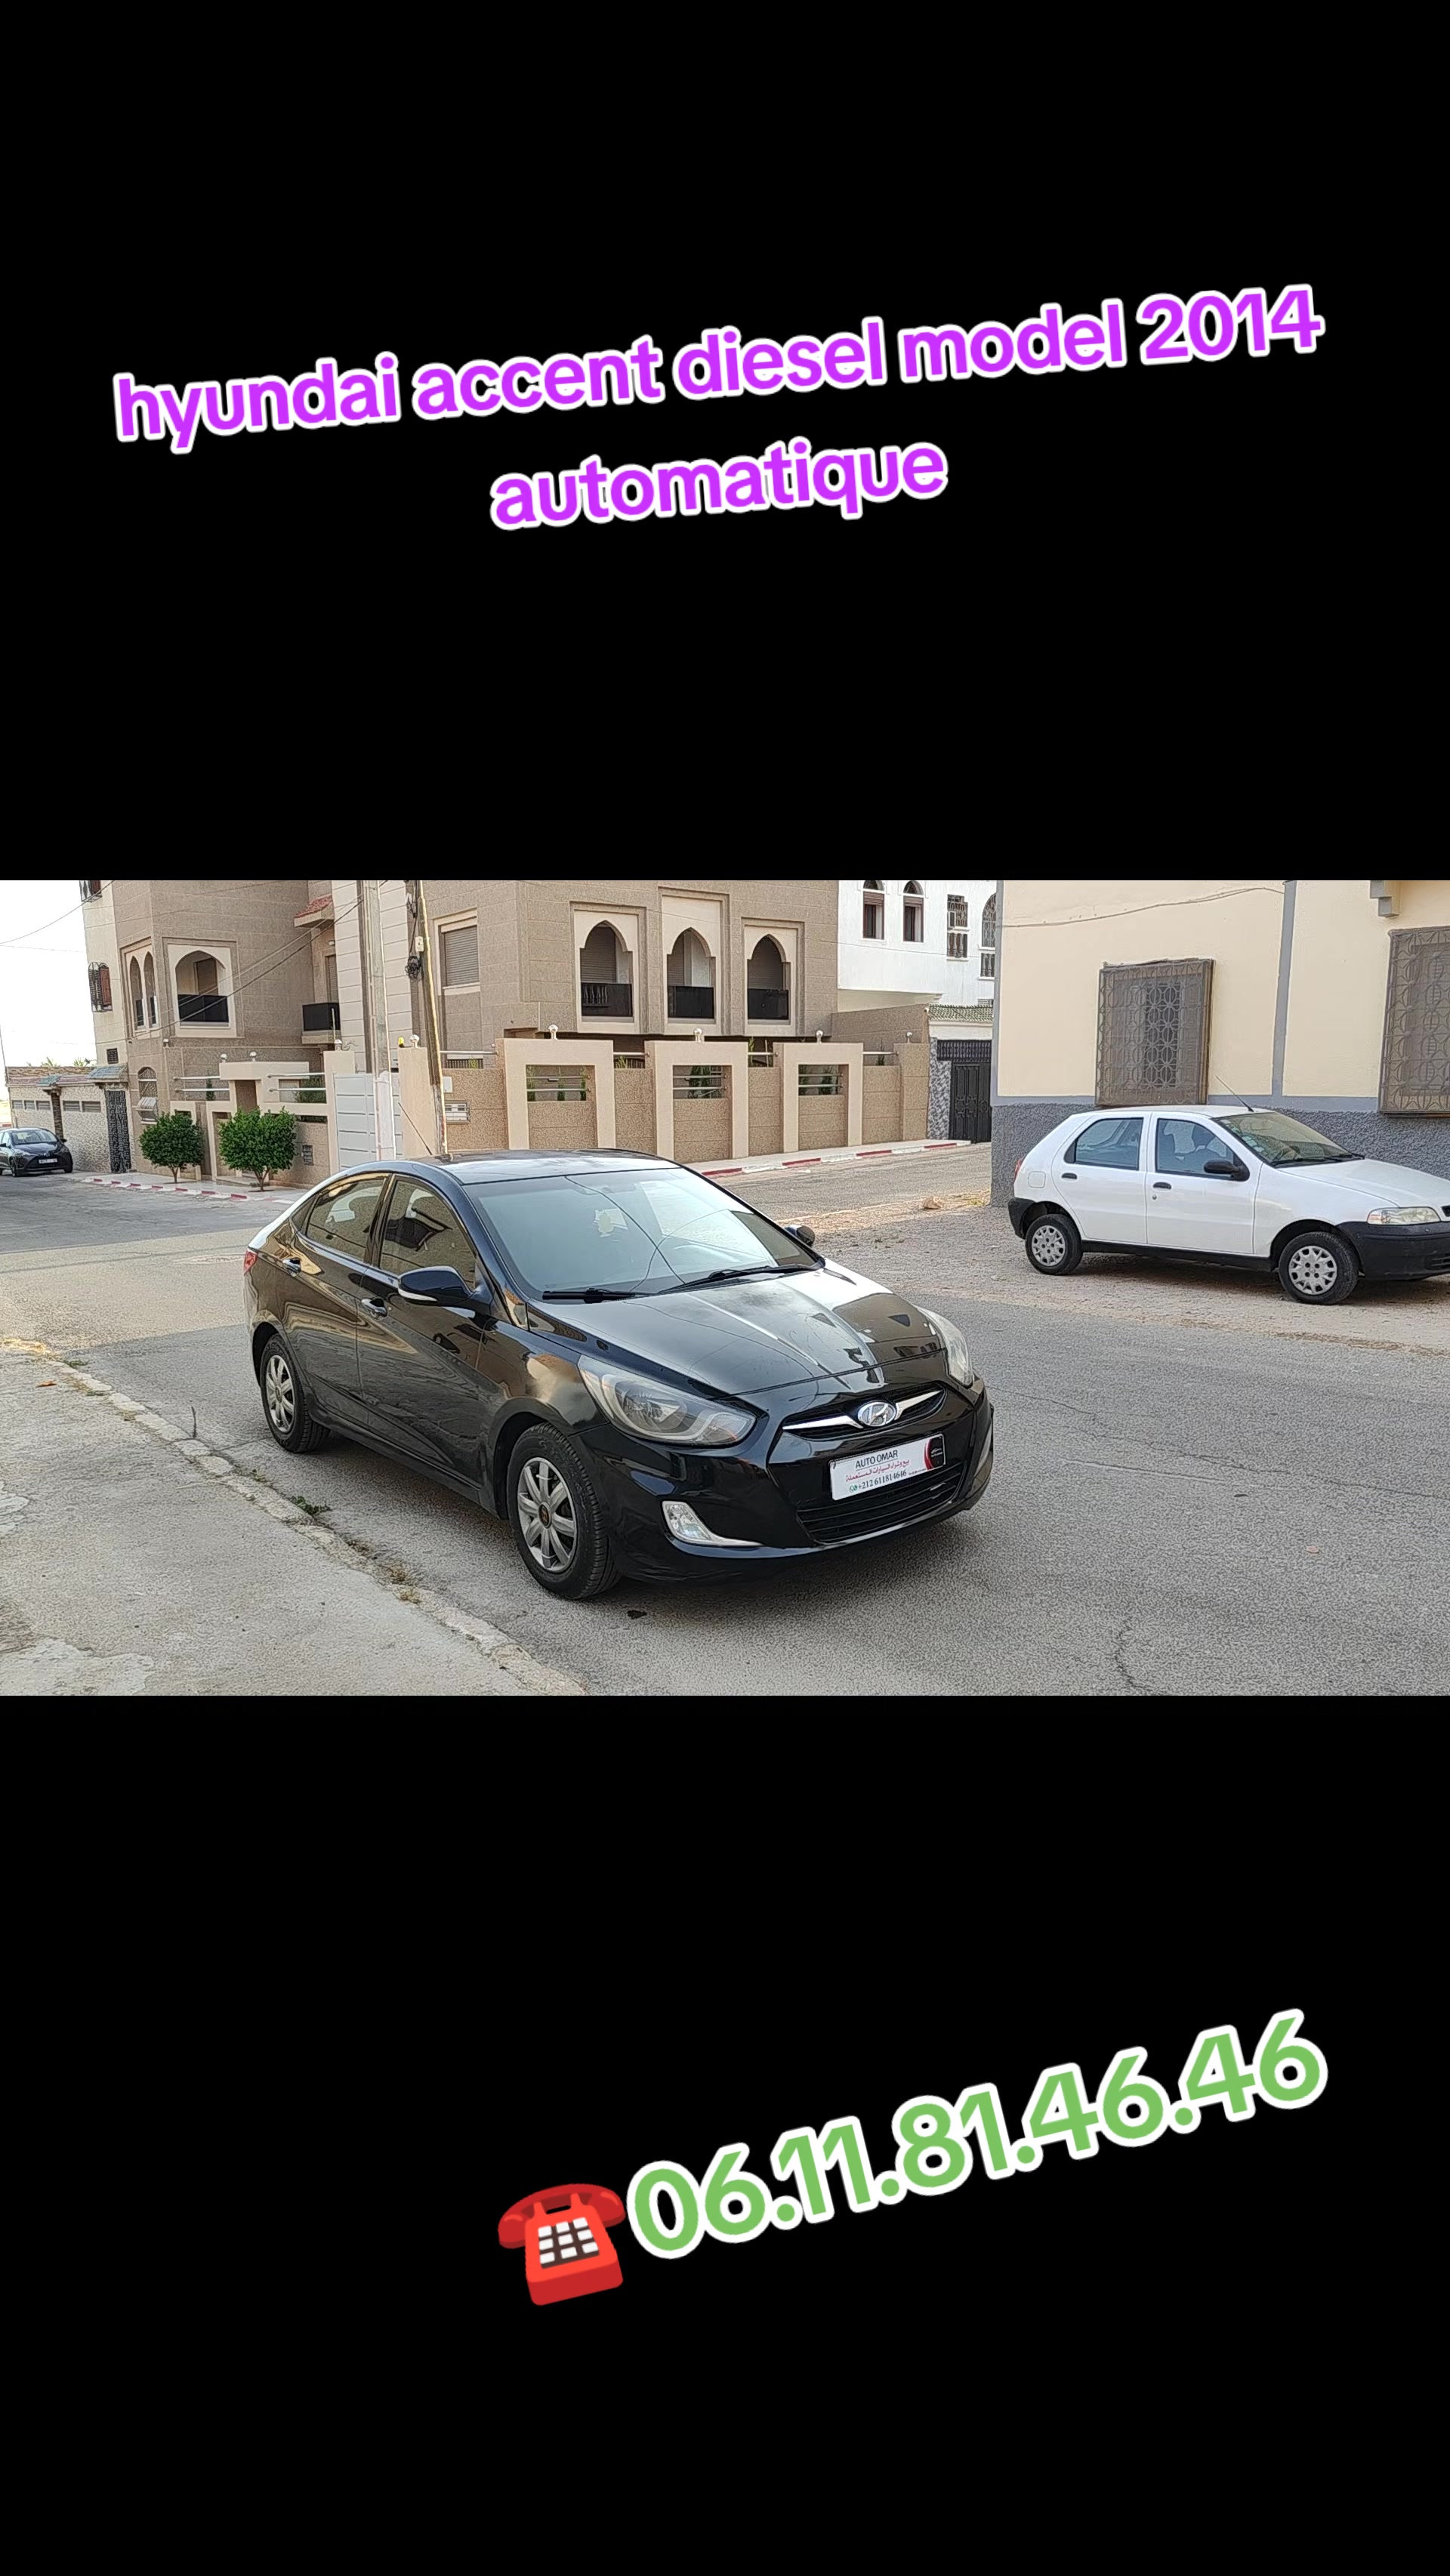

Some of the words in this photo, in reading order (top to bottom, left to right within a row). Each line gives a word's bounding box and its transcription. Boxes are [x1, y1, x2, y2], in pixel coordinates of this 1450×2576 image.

[856, 1456, 875, 1469] AUTO
[877, 1450, 899, 1462] OMAR
[858, 1479, 874, 1490] +212
[874, 1469, 907, 1486] 611814646
